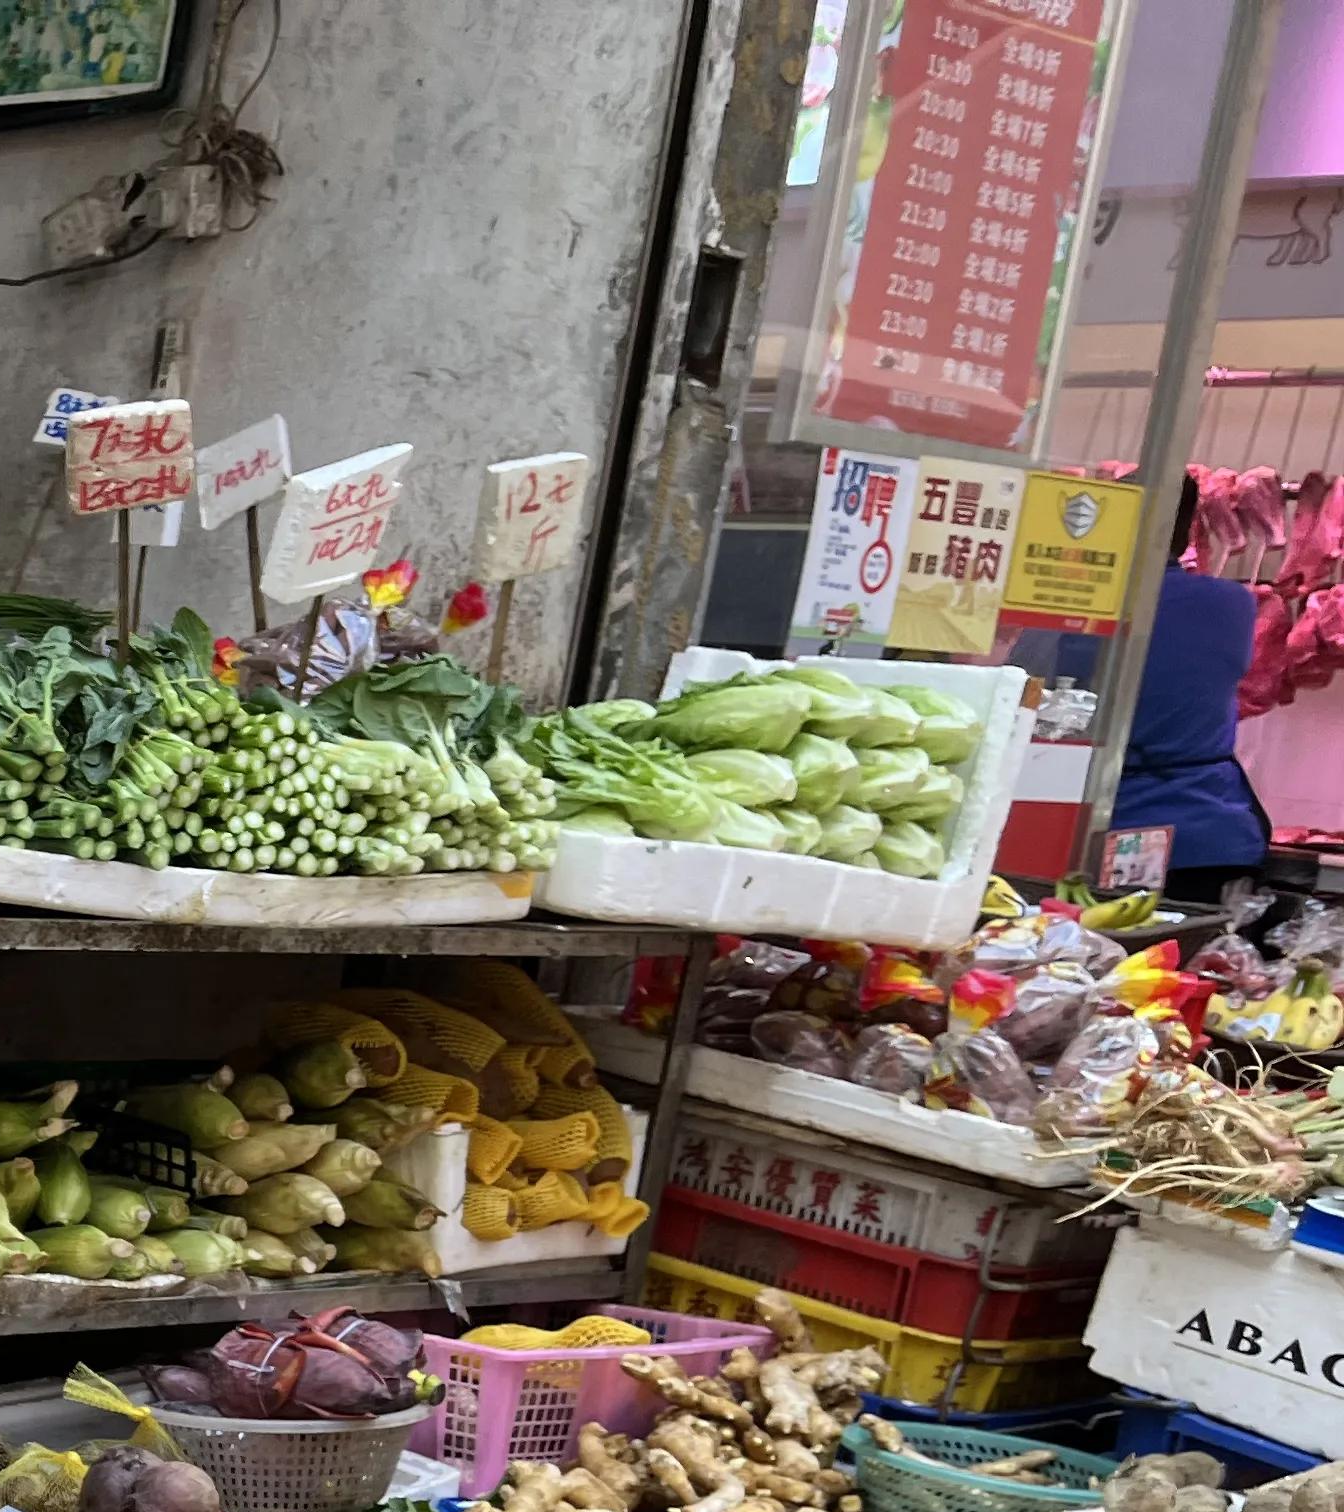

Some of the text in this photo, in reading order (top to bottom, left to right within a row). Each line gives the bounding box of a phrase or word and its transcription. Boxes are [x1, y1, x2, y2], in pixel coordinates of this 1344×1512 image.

[933, 16, 979, 49] 19:00
[927, 54, 973, 85] 19:30
[920, 89, 1048, 148] 20:00 全場7折
[913, 126, 960, 159] 20:30
[906, 164, 1036, 218] 21:00 全場5折
[900, 200, 1028, 254] 21:30 全場4折
[892, 237, 940, 267] 22:00
[886, 273, 934, 303] 22:30
[879, 310, 928, 339] 23:00
[831, 459, 899, 545] 招聘
[919, 476, 984, 527] 五豐
